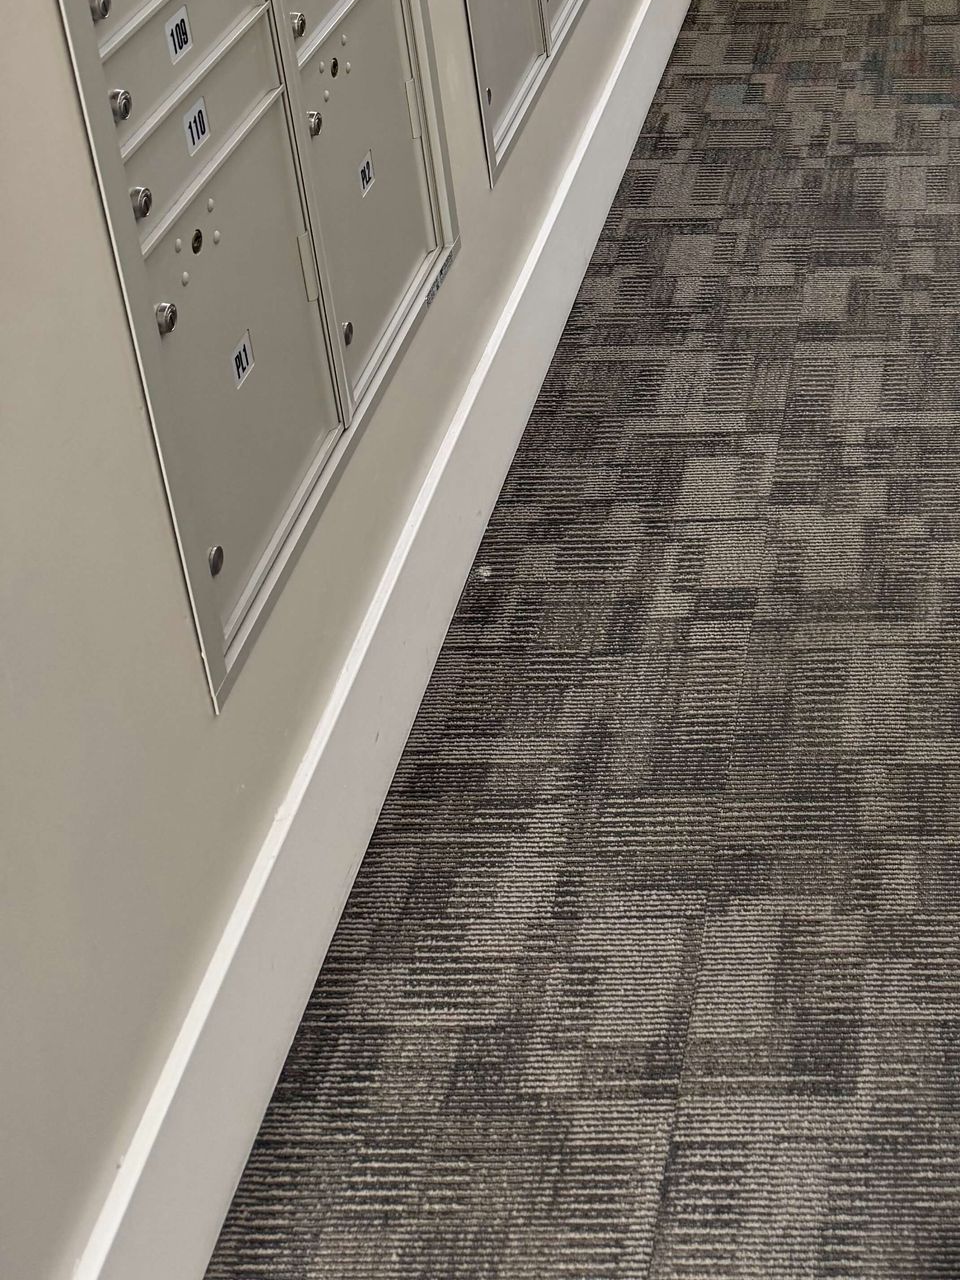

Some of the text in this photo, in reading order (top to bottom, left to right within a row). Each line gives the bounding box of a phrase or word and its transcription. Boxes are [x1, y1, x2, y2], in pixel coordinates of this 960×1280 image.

[170, 18, 189, 55] 109
[188, 109, 206, 146] 110
[360, 160, 372, 190] PL2
[234, 344, 250, 380] PL1
